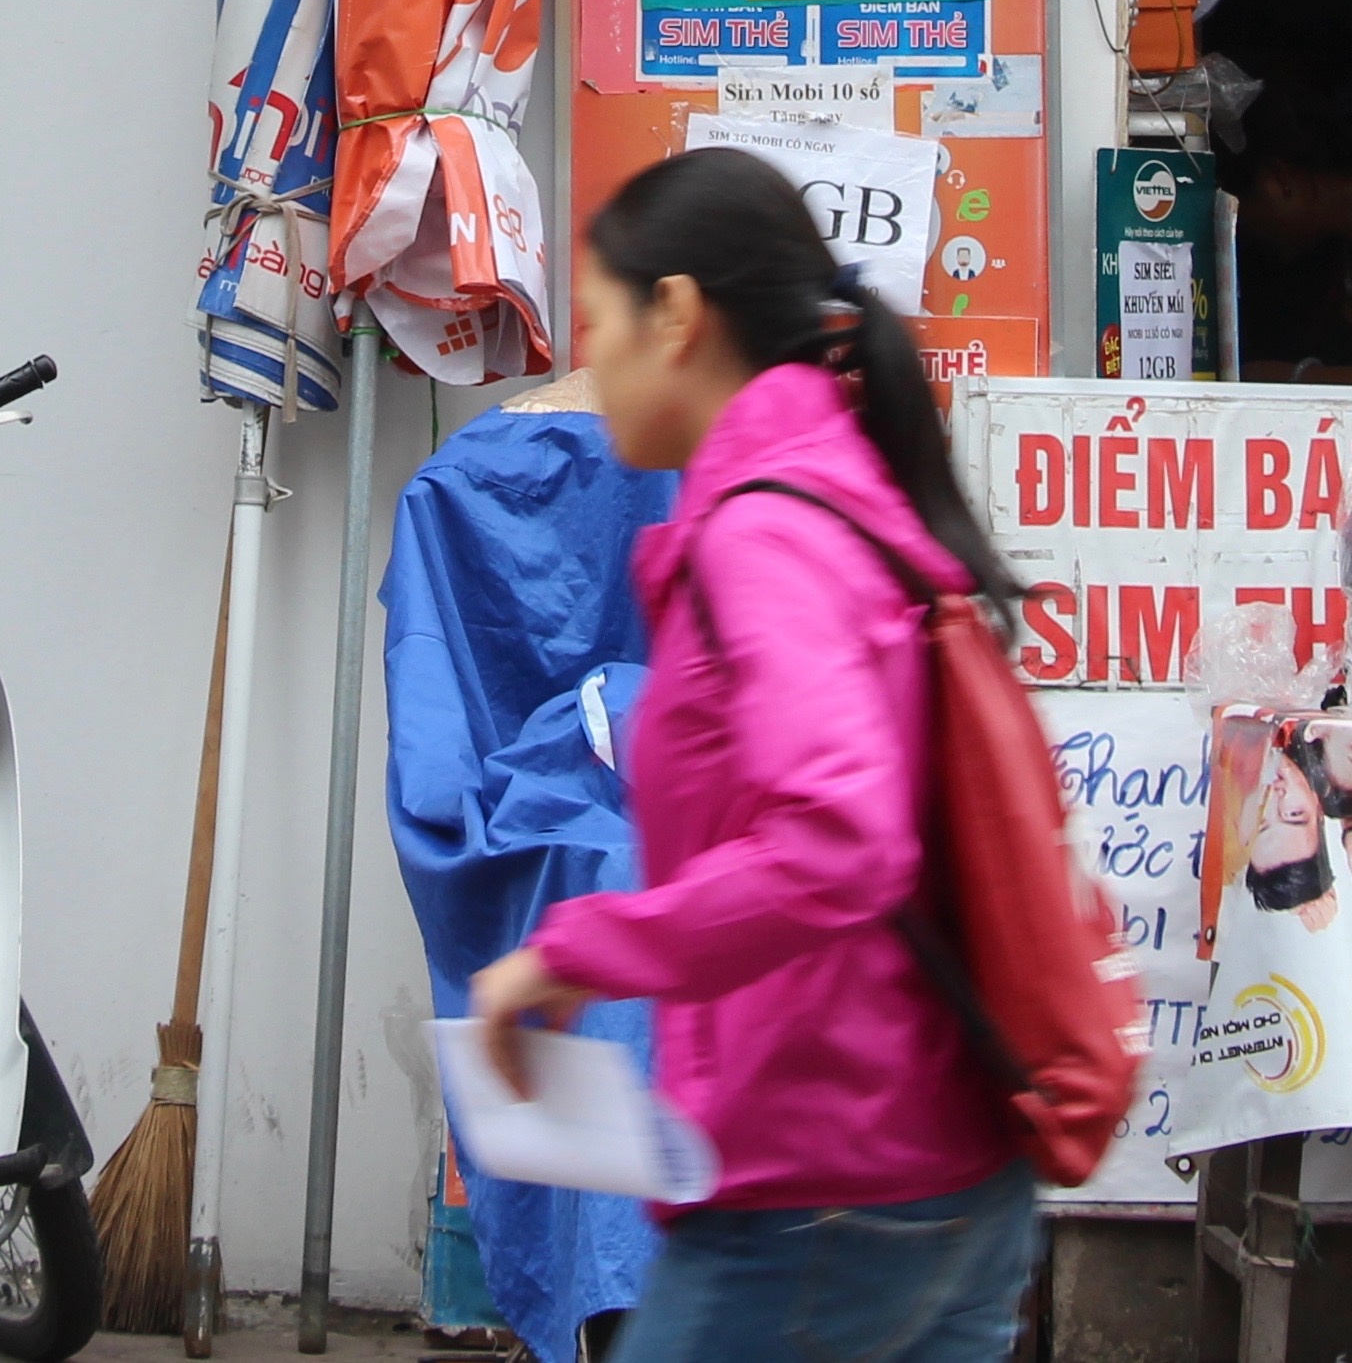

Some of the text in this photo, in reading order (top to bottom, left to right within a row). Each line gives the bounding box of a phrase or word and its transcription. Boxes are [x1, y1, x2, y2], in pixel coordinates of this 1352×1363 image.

[659, 11, 789, 48] SIM THẺ
[837, 11, 968, 49] SIM THẺ
[770, 83, 824, 102] Mobi
[831, 83, 853, 101] 10
[859, 78, 881, 102] số
[1139, 356, 1176, 380] 12GB
[1015, 397, 1215, 531] ĐIỂM
